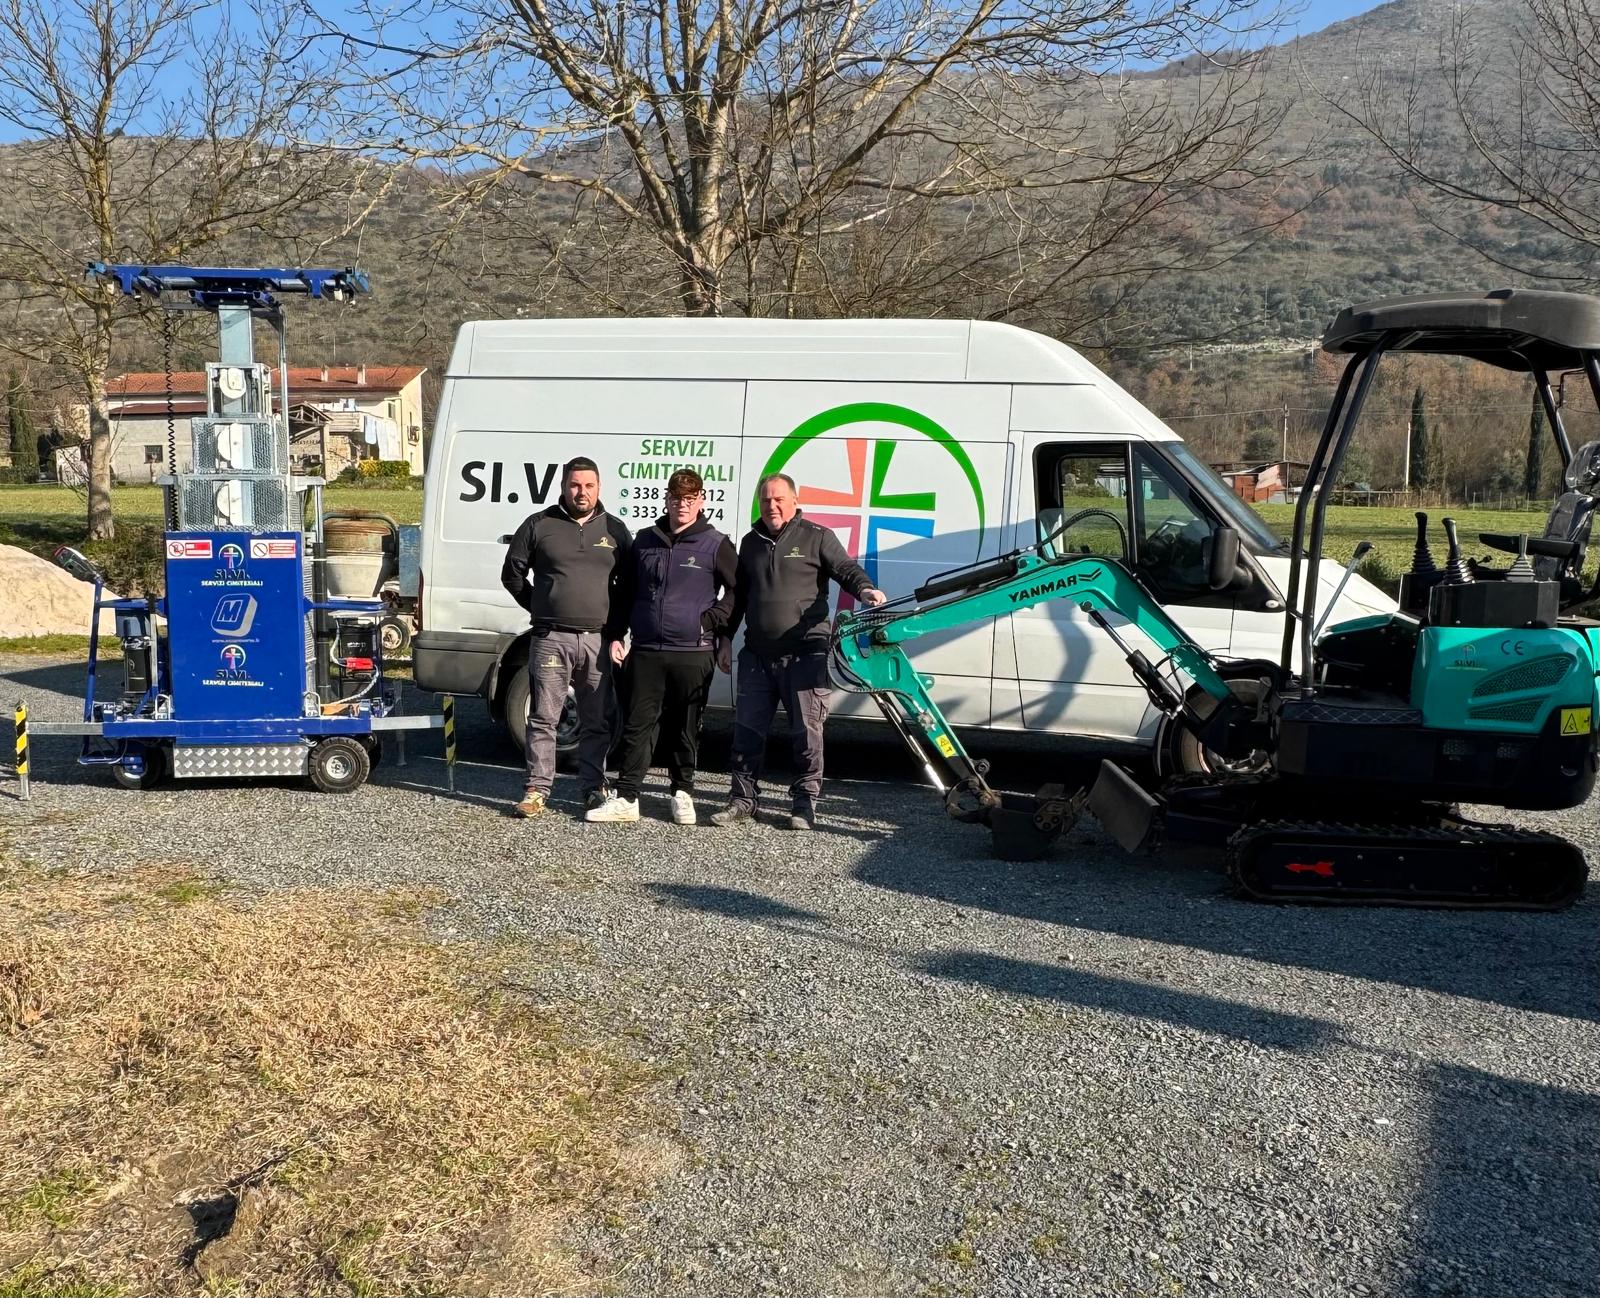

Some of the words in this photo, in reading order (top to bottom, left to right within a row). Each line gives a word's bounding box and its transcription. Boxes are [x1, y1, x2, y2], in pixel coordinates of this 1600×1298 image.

[641, 439, 714, 457] SERVIZI
[633, 487, 659, 500] 338
[632, 505, 658, 519] 333
[1009, 575, 1077, 602] YANMAR
[1501, 640, 1524, 656] CE
